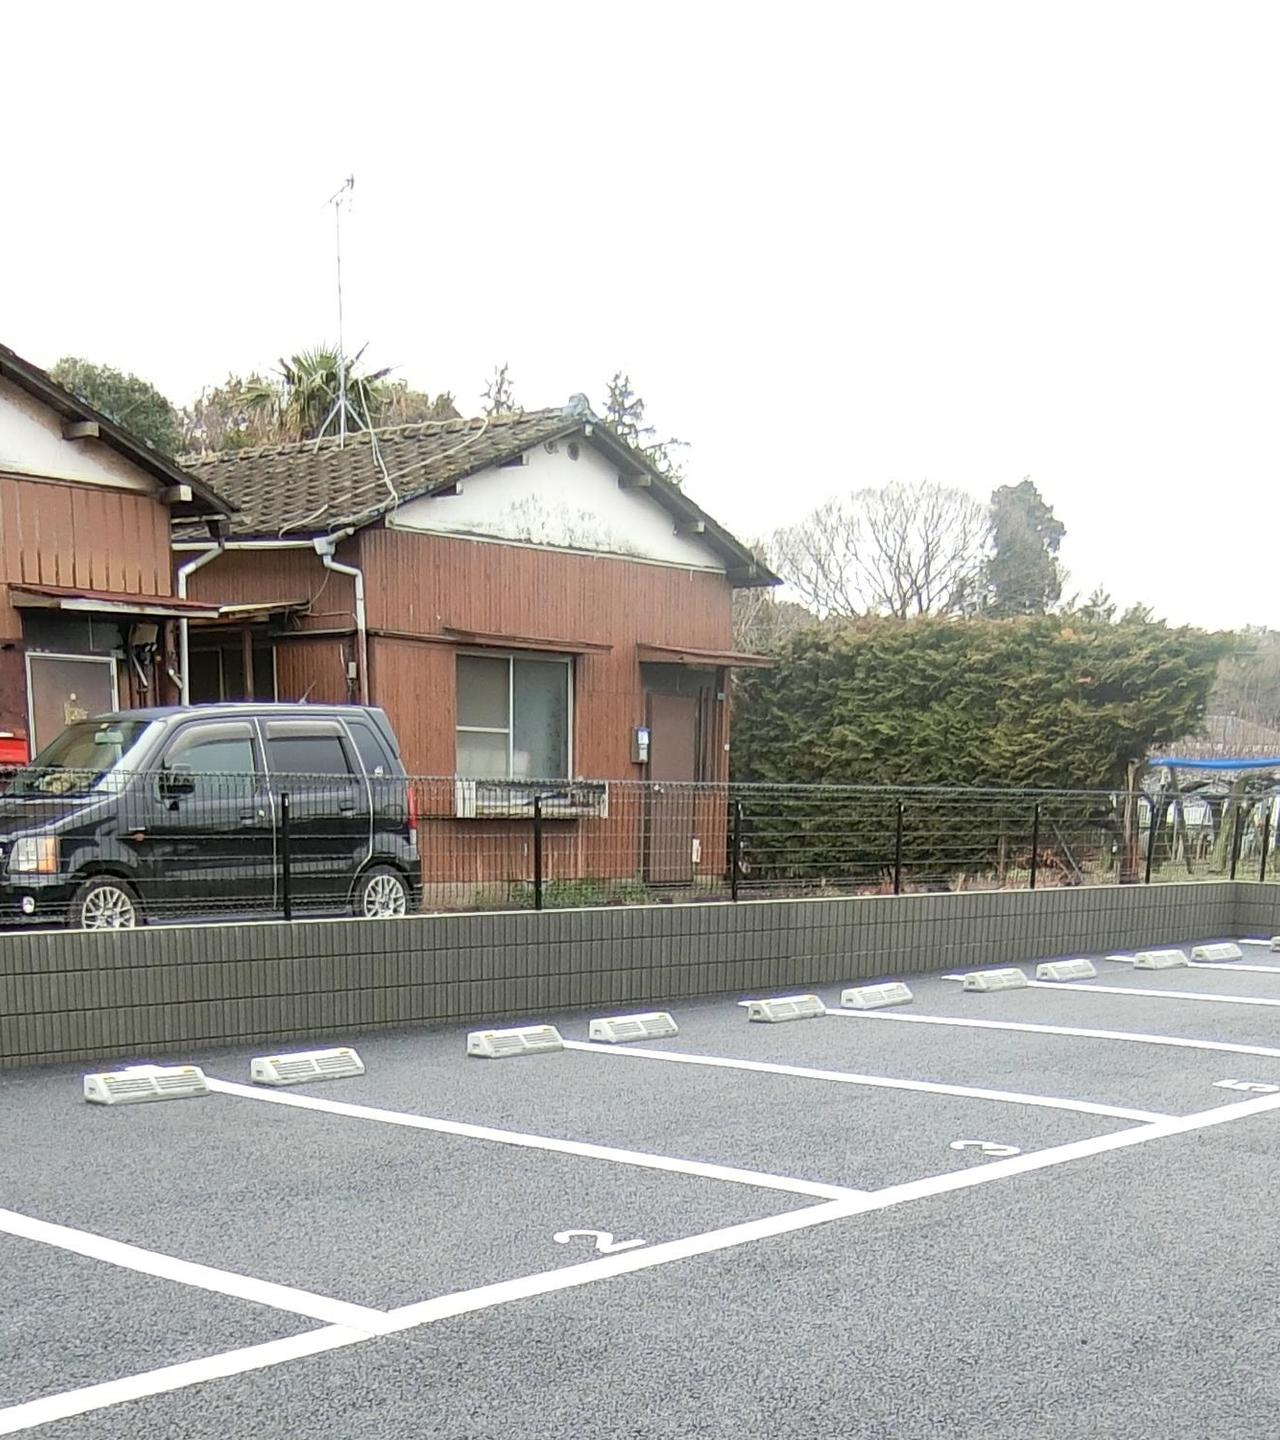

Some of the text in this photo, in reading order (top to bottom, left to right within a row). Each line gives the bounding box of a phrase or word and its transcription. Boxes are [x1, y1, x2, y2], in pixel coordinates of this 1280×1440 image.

[1211, 1079, 1280, 1093] 5
[949, 1140, 1020, 1156] 3
[553, 1229, 646, 1254] 2
